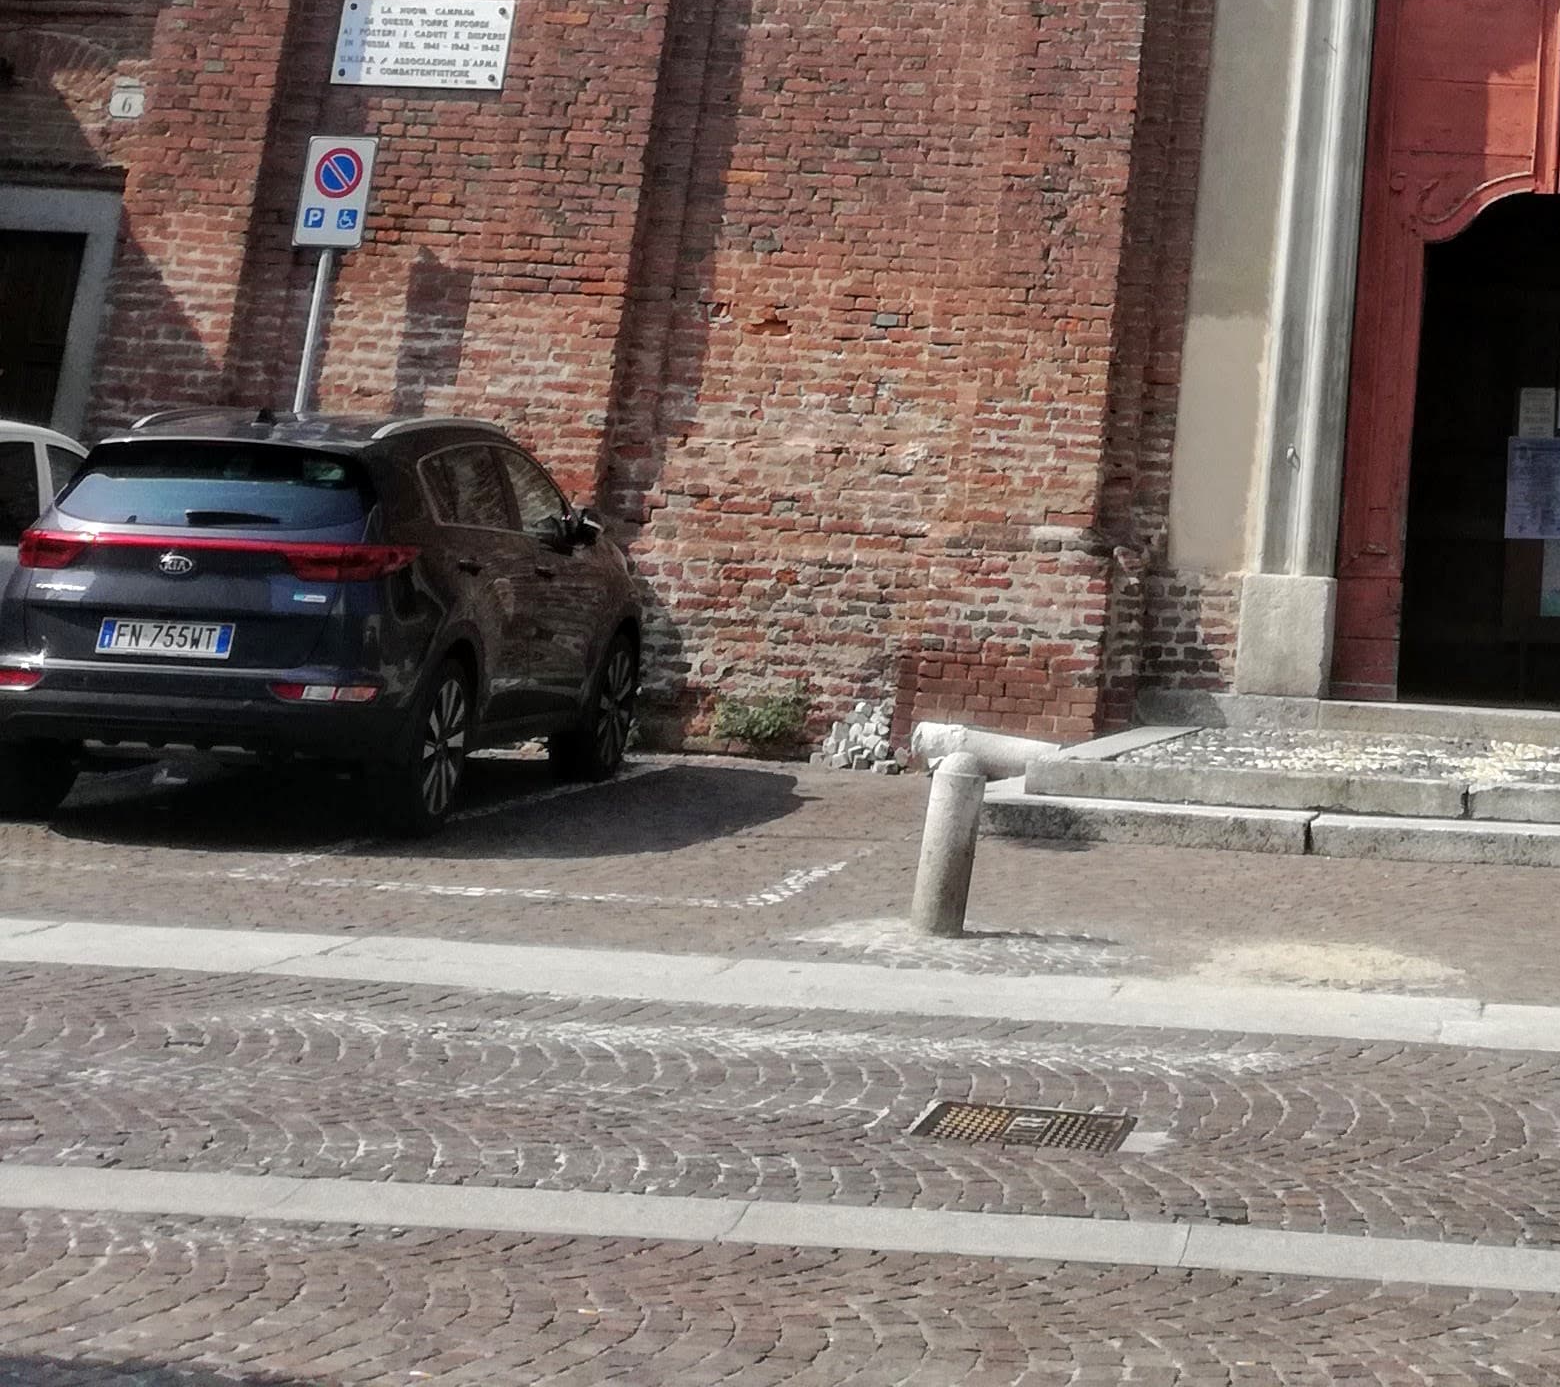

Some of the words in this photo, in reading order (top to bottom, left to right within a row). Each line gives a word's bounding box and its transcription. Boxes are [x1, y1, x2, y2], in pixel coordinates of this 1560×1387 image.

[380, 6, 392, 15] LA
[414, 30, 447, 39] CADUTI
[122, 97, 131, 114] 6
[308, 210, 322, 226] P
[162, 557, 187, 572] KIA
[116, 623, 143, 647] FN
[150, 624, 217, 651] 755WT
